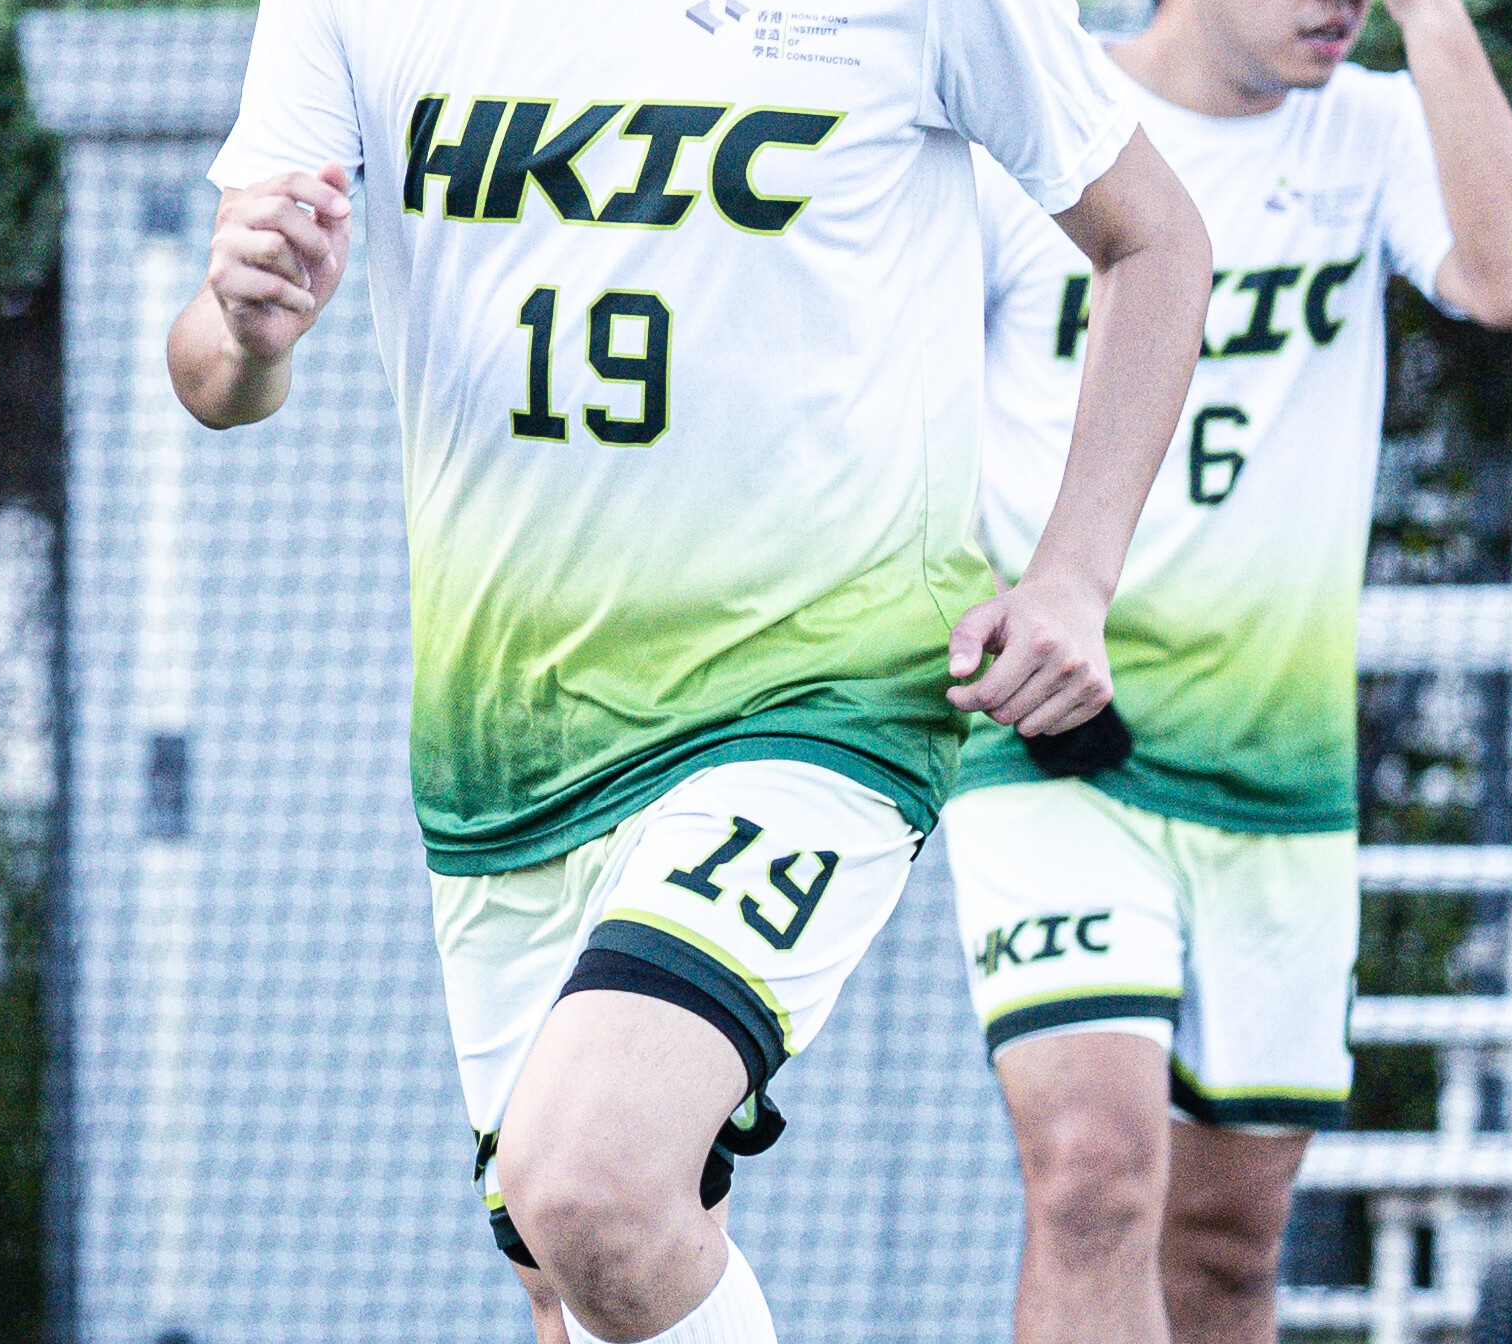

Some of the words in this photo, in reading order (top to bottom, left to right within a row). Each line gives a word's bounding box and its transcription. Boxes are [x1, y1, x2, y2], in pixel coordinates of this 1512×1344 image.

[786, 52, 861, 66] CONSTRUCTION
[787, 38, 800, 46] OF
[789, 26, 838, 36] INSTITUTE
[791, 13, 818, 21] HONG
[821, 15, 849, 24] KONG
[402, 93, 848, 235] HKIC
[1054, 252, 1367, 360] HIC
[510, 284, 673, 447] 19
[1188, 404, 1249, 506] 6
[665, 816, 840, 952] 19
